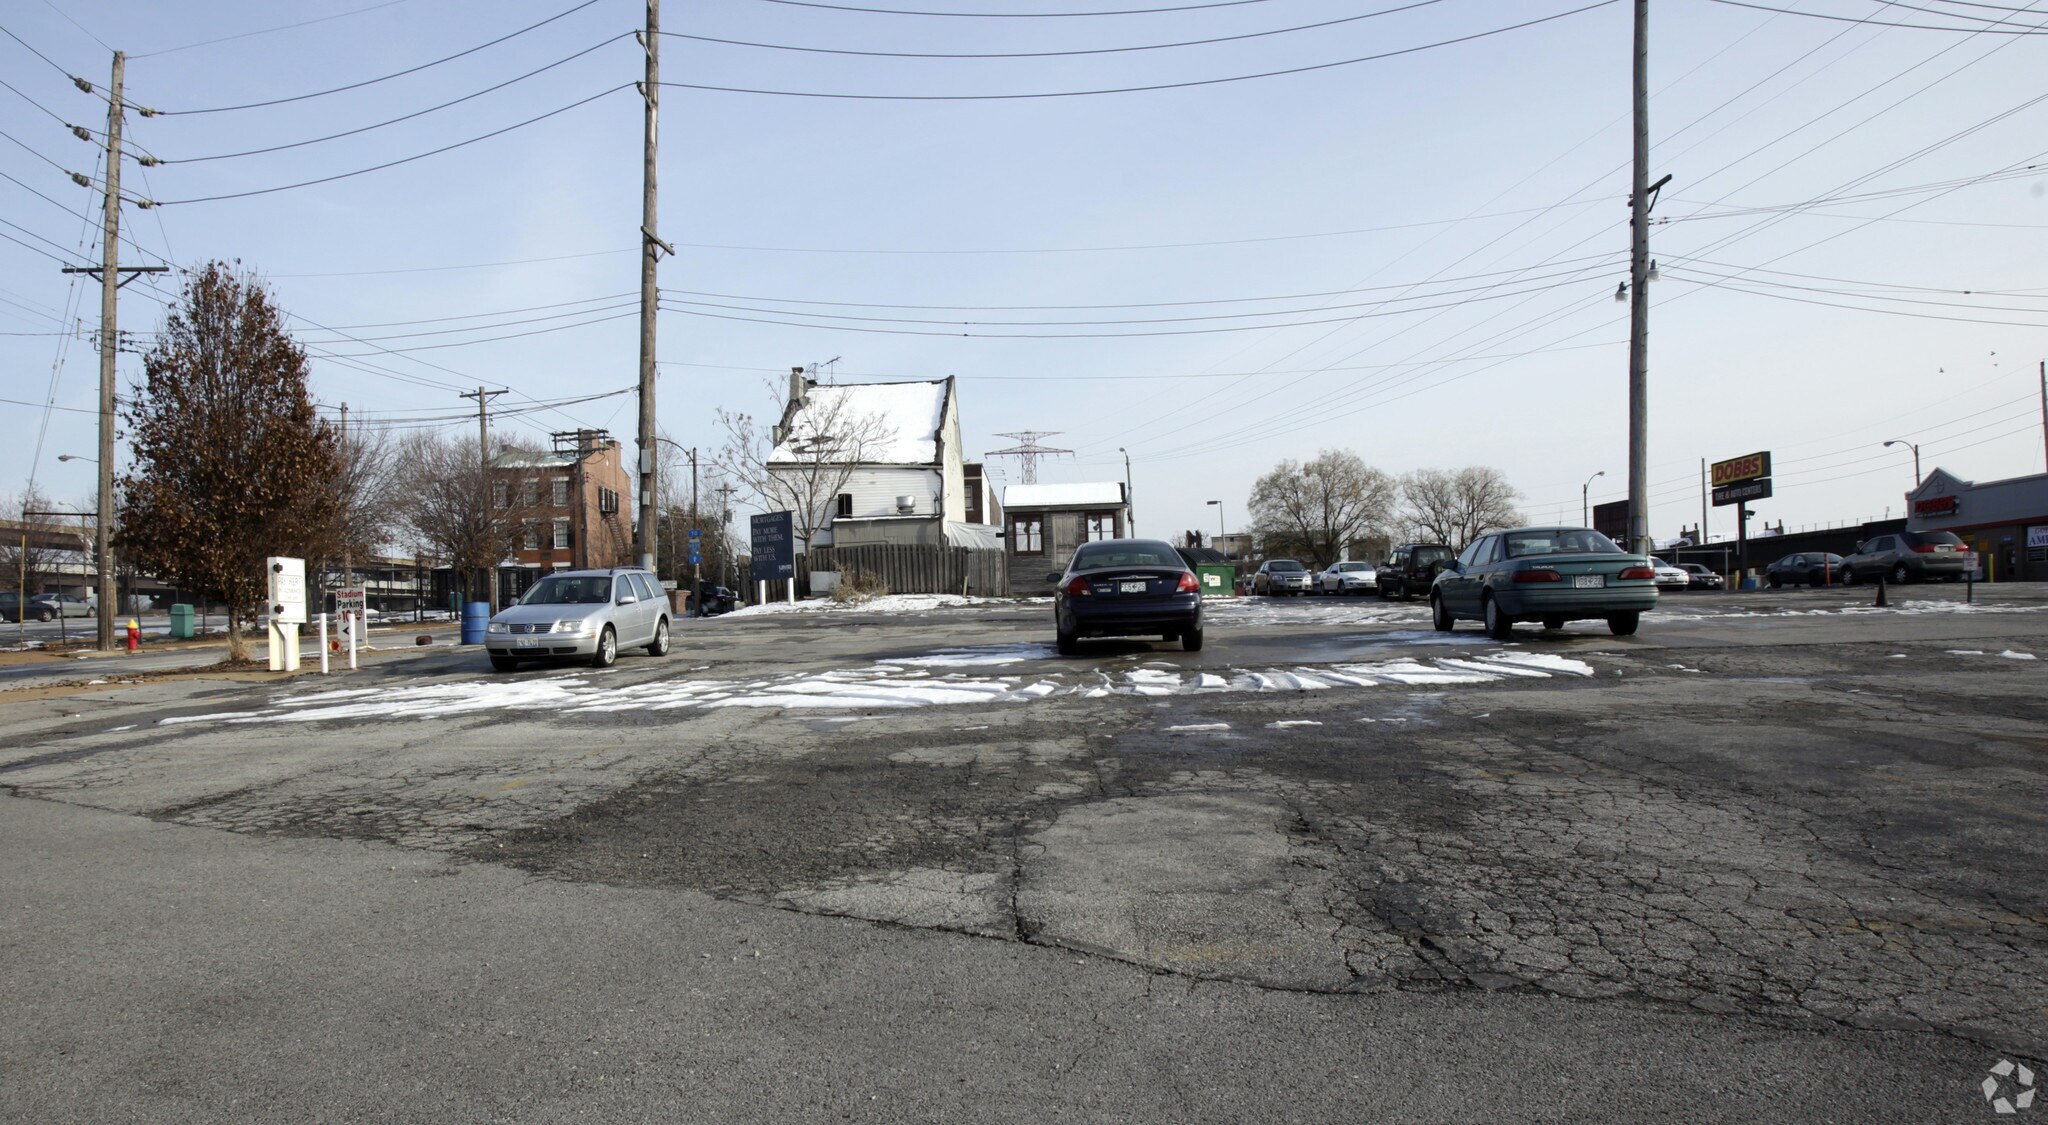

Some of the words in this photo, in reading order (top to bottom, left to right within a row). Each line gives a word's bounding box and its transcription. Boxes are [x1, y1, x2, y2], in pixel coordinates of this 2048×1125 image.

[1715, 456, 1760, 482] DOBBS
[1742, 484, 1762, 496] CENTERS
[753, 528, 762, 536] PAY
[763, 526, 778, 534] MORE
[753, 547, 762, 555] PAY
[764, 546, 775, 554] LESS
[754, 554, 768, 562] WITH
[337, 590, 364, 599] Stadium
[337, 599, 364, 609] Parking
